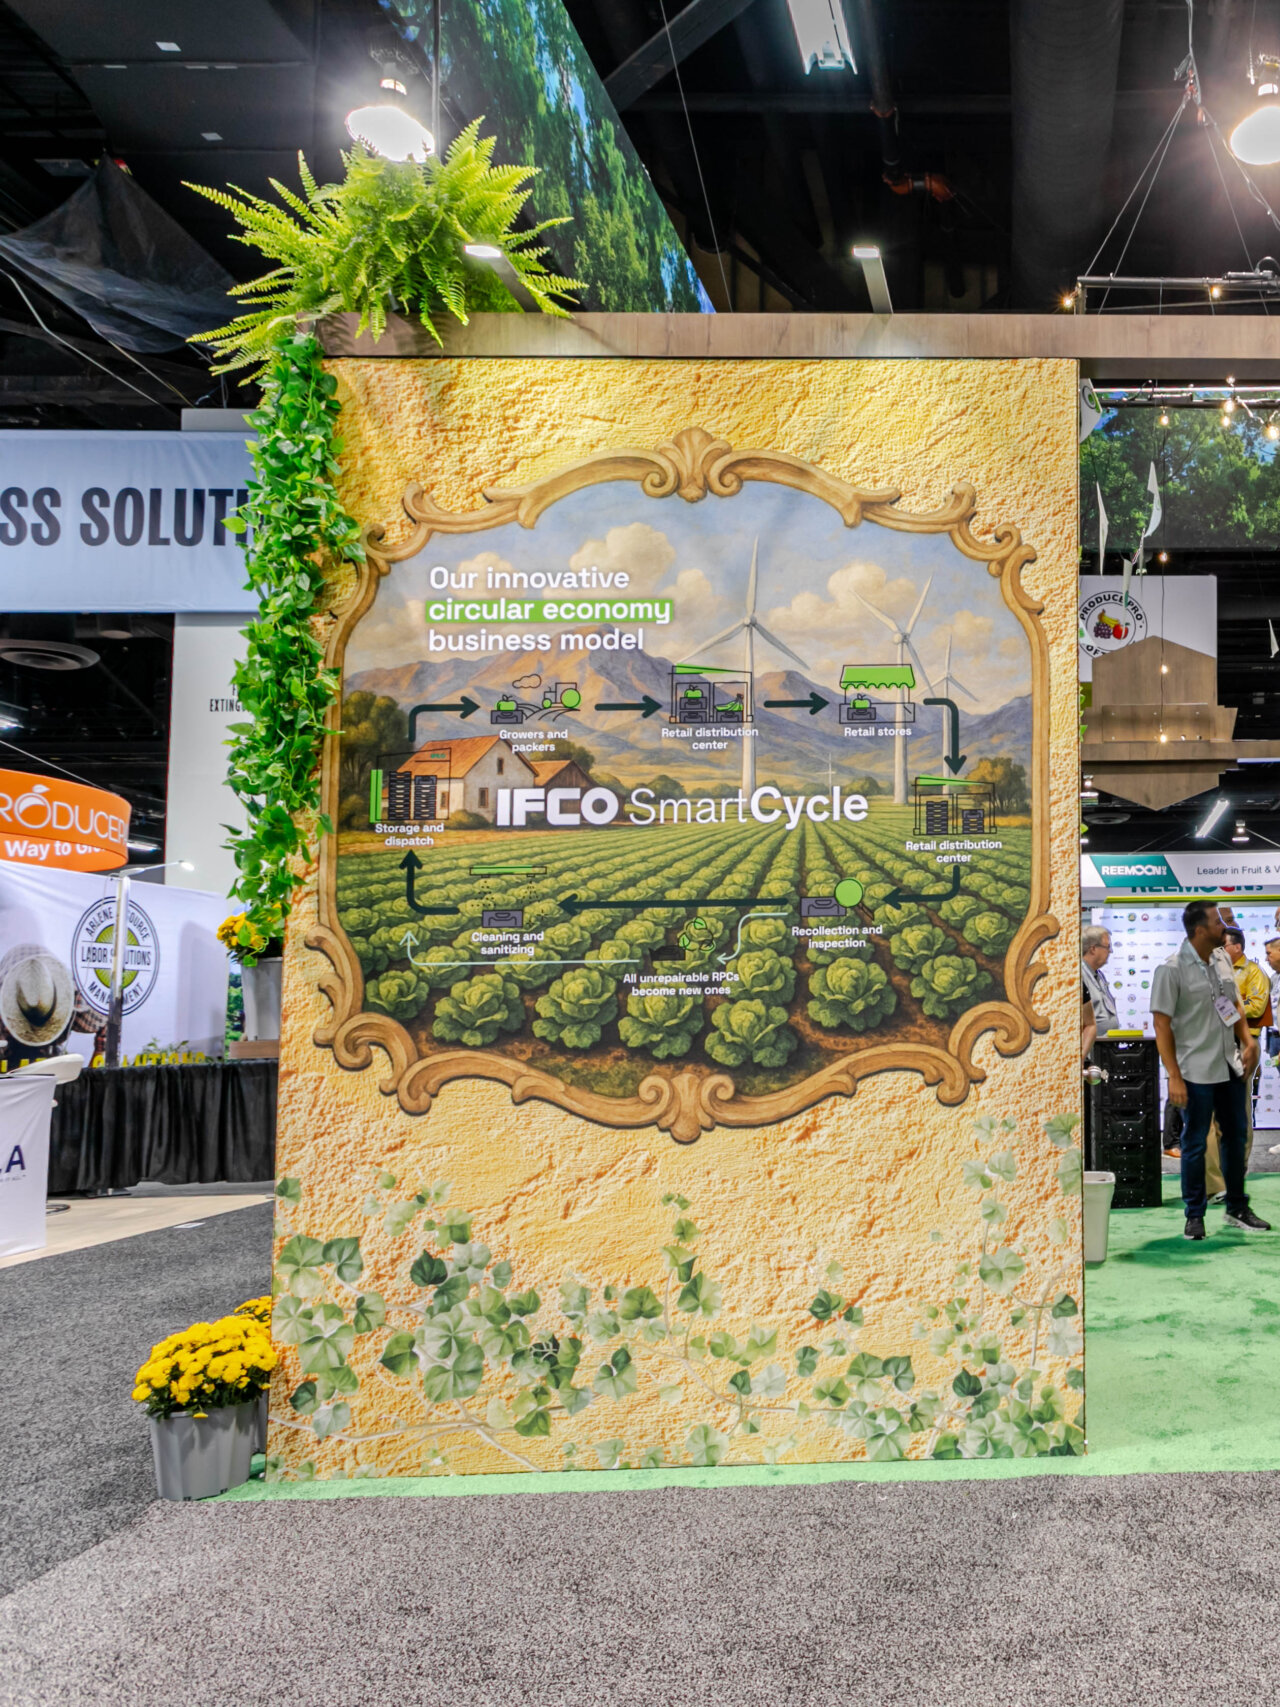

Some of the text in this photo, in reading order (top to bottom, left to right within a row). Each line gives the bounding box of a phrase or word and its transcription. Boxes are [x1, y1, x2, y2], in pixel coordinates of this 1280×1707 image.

[80, 487, 262, 547] SOLUTI
[430, 566, 630, 589] Our innovative
[428, 597, 670, 624] circular economy
[1127, 600, 1144, 621] PRO
[429, 628, 644, 651] business model
[209, 698, 249, 712] EXTING
[499, 729, 568, 740] Growers and
[661, 726, 759, 738] Retail distribution
[844, 726, 912, 737] Retail stores
[511, 742, 556, 753] packers
[692, 740, 728, 750] center
[496, 786, 868, 830] IFCO SmartCycle
[375, 822, 444, 835] Storage and
[384, 836, 434, 847] dispatch
[905, 839, 1002, 851] Retail distribution
[4, 841, 50, 860] Way
[55, 841, 71, 855] to
[936, 853, 972, 863] center
[1102, 865, 1161, 875] REEMOON
[1197, 866, 1228, 875] Leader
[1231, 866, 1239, 874] in
[1242, 866, 1262, 874] Fruit
[1264, 865, 1271, 873] &
[85, 906, 113, 936] ARLENE
[791, 924, 883, 936] Recollection and
[471, 931, 544, 943] Cleaning and
[481, 944, 534, 956] sanitizing
[808, 938, 866, 950] inspection
[81, 946, 108, 963] LABOR
[623, 972, 739, 984] All unrepairable RPCs
[631, 986, 731, 996] become new ones
